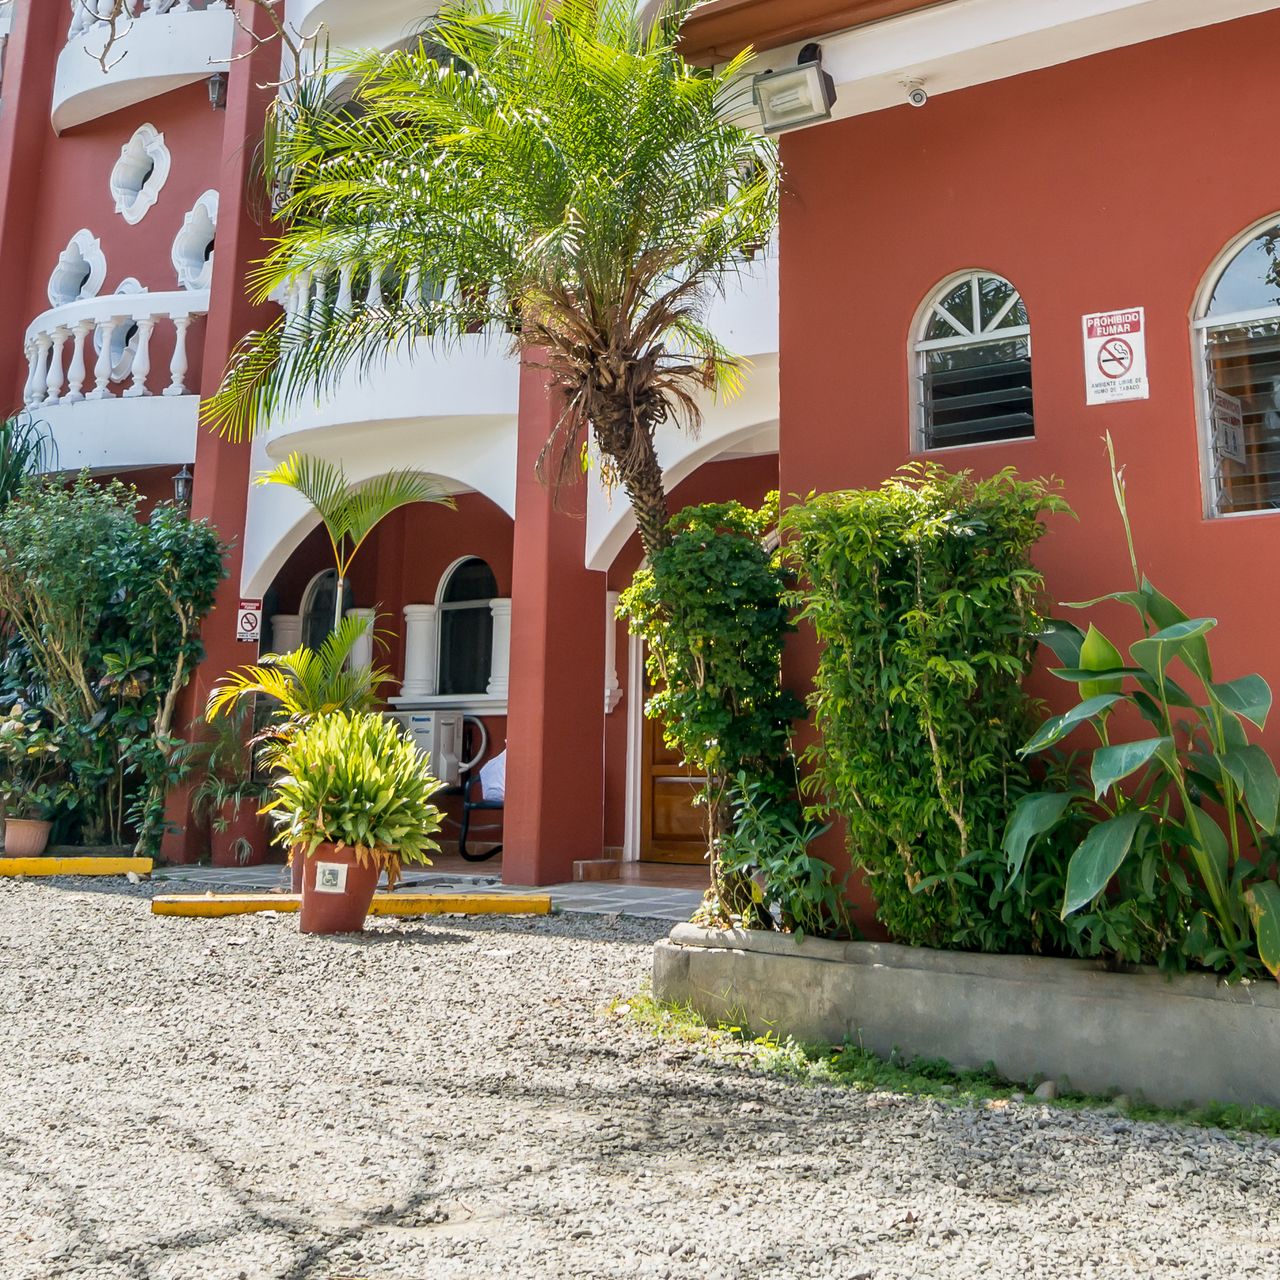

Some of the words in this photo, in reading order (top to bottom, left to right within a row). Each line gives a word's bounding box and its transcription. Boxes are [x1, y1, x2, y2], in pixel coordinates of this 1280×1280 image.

[1087, 313, 1139, 328] PROHIBIDO
[1096, 323, 1131, 336] FUMAR
[1091, 380, 1116, 388] AMBIENTE
